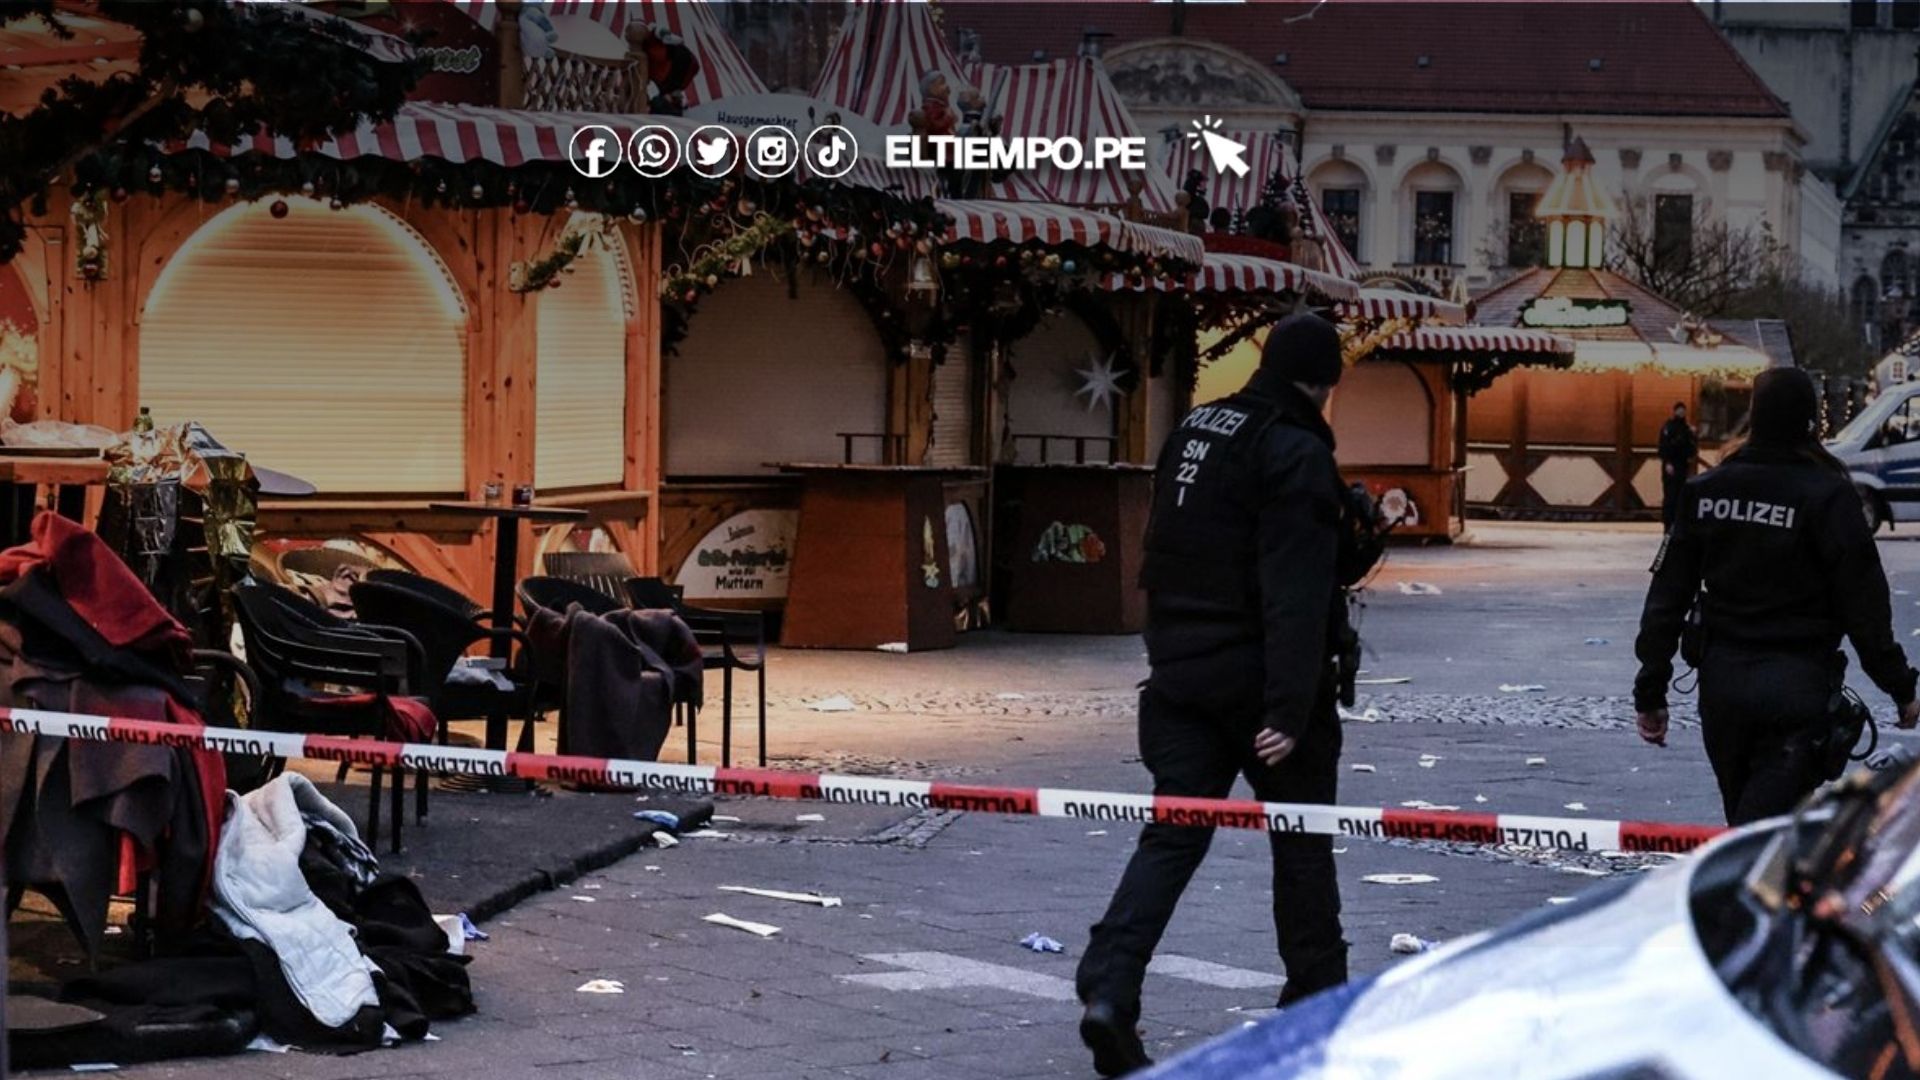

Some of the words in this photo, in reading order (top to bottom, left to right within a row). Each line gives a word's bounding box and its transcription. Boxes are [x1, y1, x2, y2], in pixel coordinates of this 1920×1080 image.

[1181, 405, 1249, 437] POLIZEI
[1182, 438, 1211, 462] SN
[1175, 461, 1199, 484] 22
[1696, 497, 1796, 529] POLIZEI
[715, 576, 763, 590] Muttern
